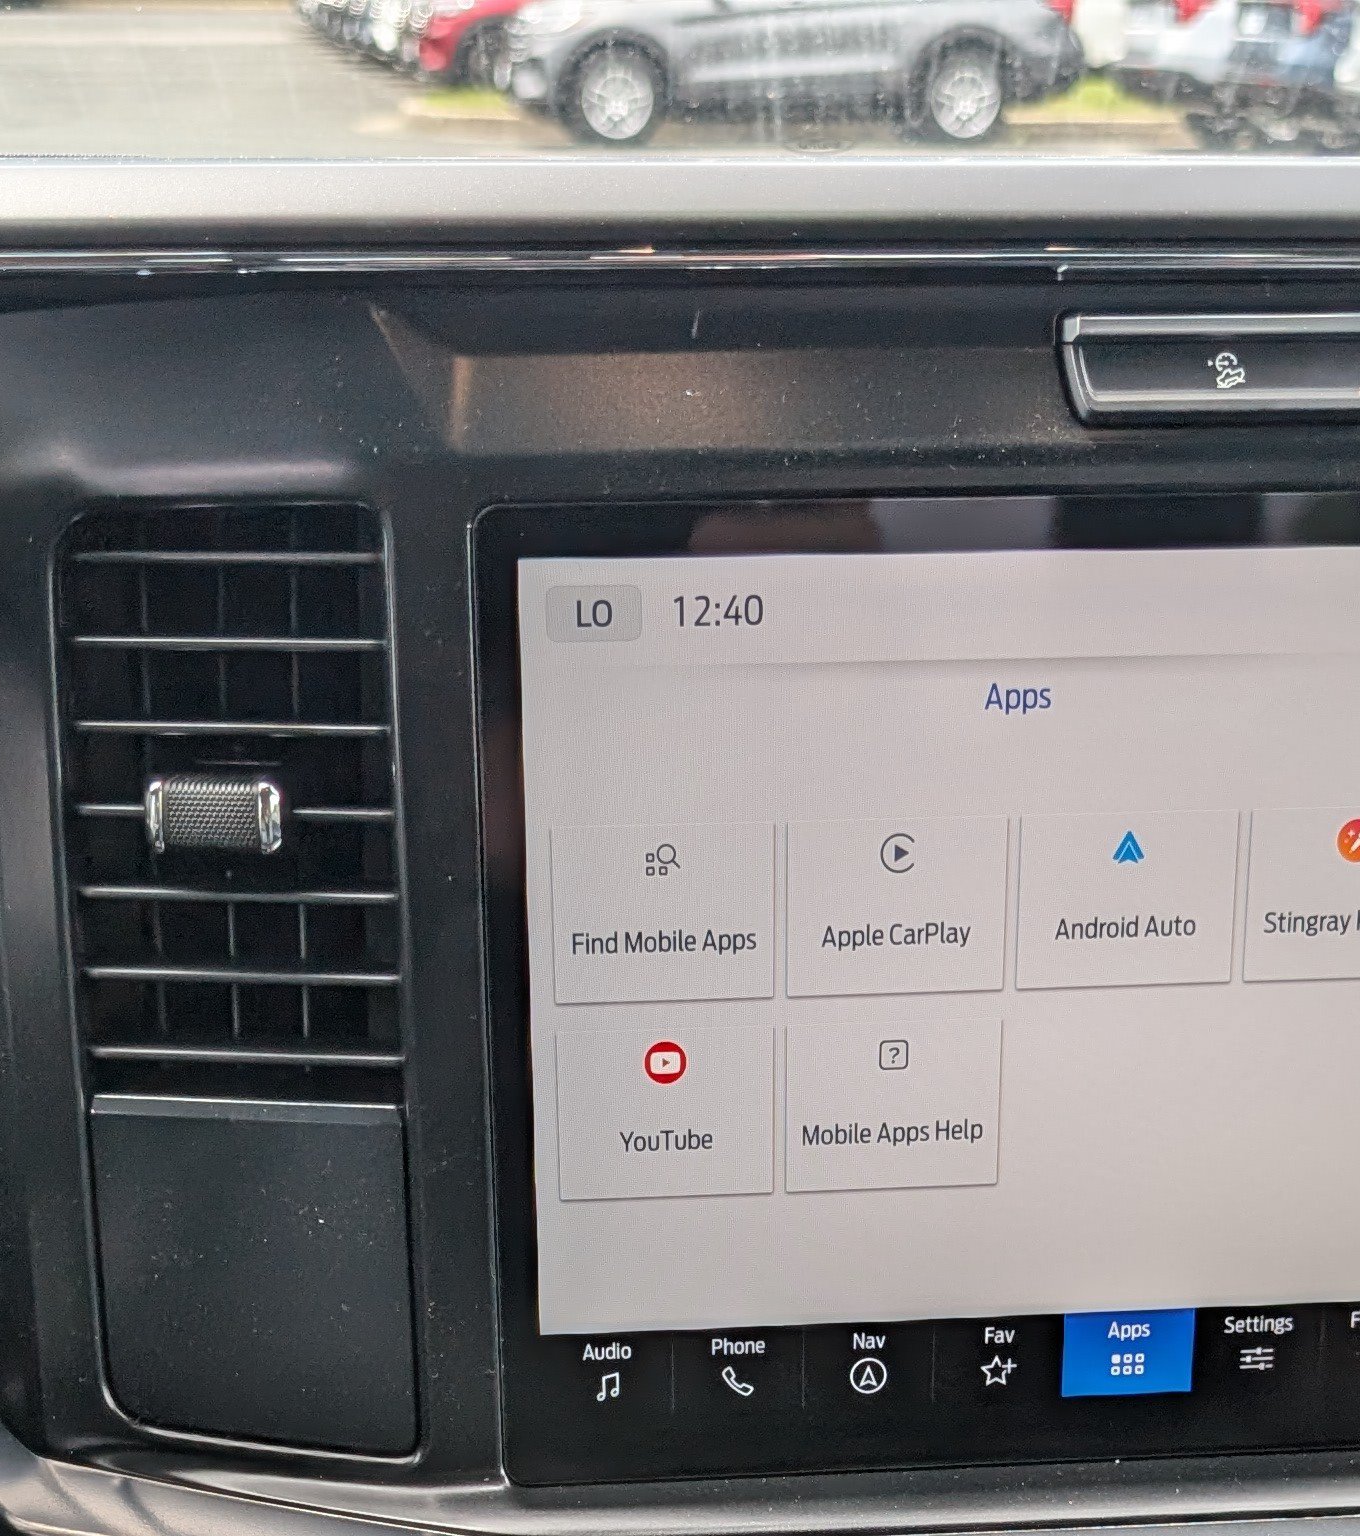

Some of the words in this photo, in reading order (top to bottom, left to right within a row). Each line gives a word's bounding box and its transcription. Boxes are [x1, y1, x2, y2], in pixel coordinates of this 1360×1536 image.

[575, 599, 613, 629] LO
[673, 594, 764, 628] 12:40
[984, 683, 1052, 714] Apps
[821, 923, 885, 951] Apple
[889, 919, 972, 949] CarPlay
[1054, 915, 1140, 941] Android
[1144, 914, 1197, 938] Auto
[1263, 909, 1352, 938] Stingray
[571, 930, 619, 956] Find
[623, 929, 697, 954] Mobile
[702, 929, 758, 954] Apps
[620, 1129, 713, 1152] YouTube
[801, 1121, 872, 1147] Mobile
[877, 1121, 930, 1146] Apps
[935, 1119, 984, 1144] Help
[984, 1327, 1016, 1346] Fav
[1107, 1320, 1151, 1340] Apps
[1223, 1313, 1294, 1335] Settings
[582, 1342, 633, 1361] Audio
[711, 1337, 766, 1356] Phone
[852, 1332, 886, 1350] Nav
